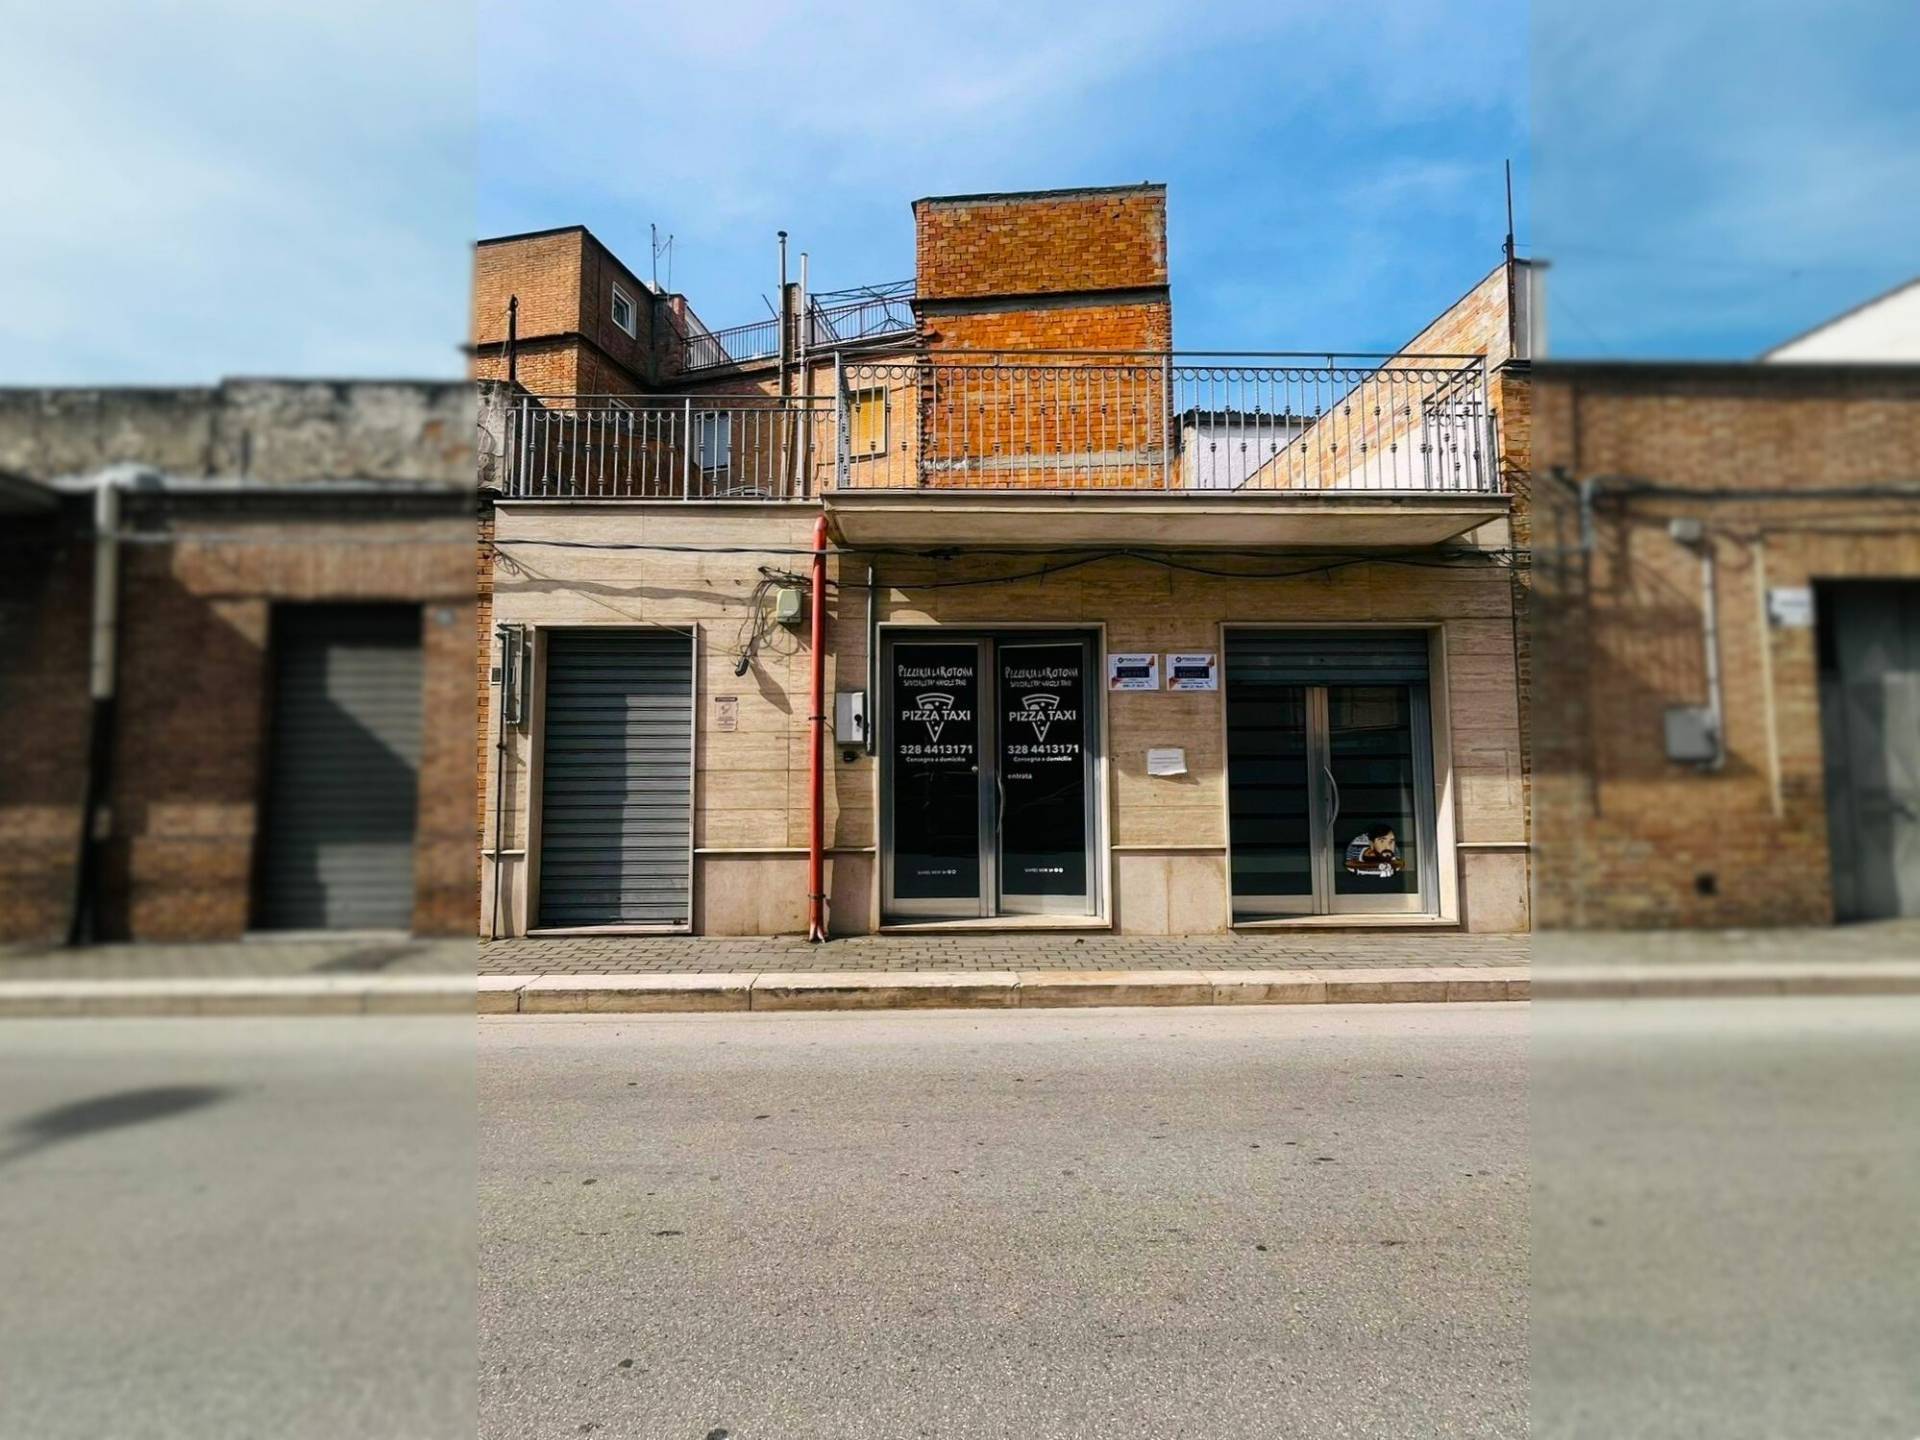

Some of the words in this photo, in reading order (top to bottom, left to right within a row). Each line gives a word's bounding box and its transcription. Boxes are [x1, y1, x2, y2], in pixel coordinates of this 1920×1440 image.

[902, 710, 940, 721] PIZZA
[941, 710, 971, 721] TAXI
[1009, 711, 1046, 722] PIZZA
[1047, 710, 1077, 721] TAXI
[900, 744, 922, 754] 328
[924, 744, 973, 754] 4413171
[1008, 745, 1029, 755] 328
[1030, 744, 1079, 754] 4413171
